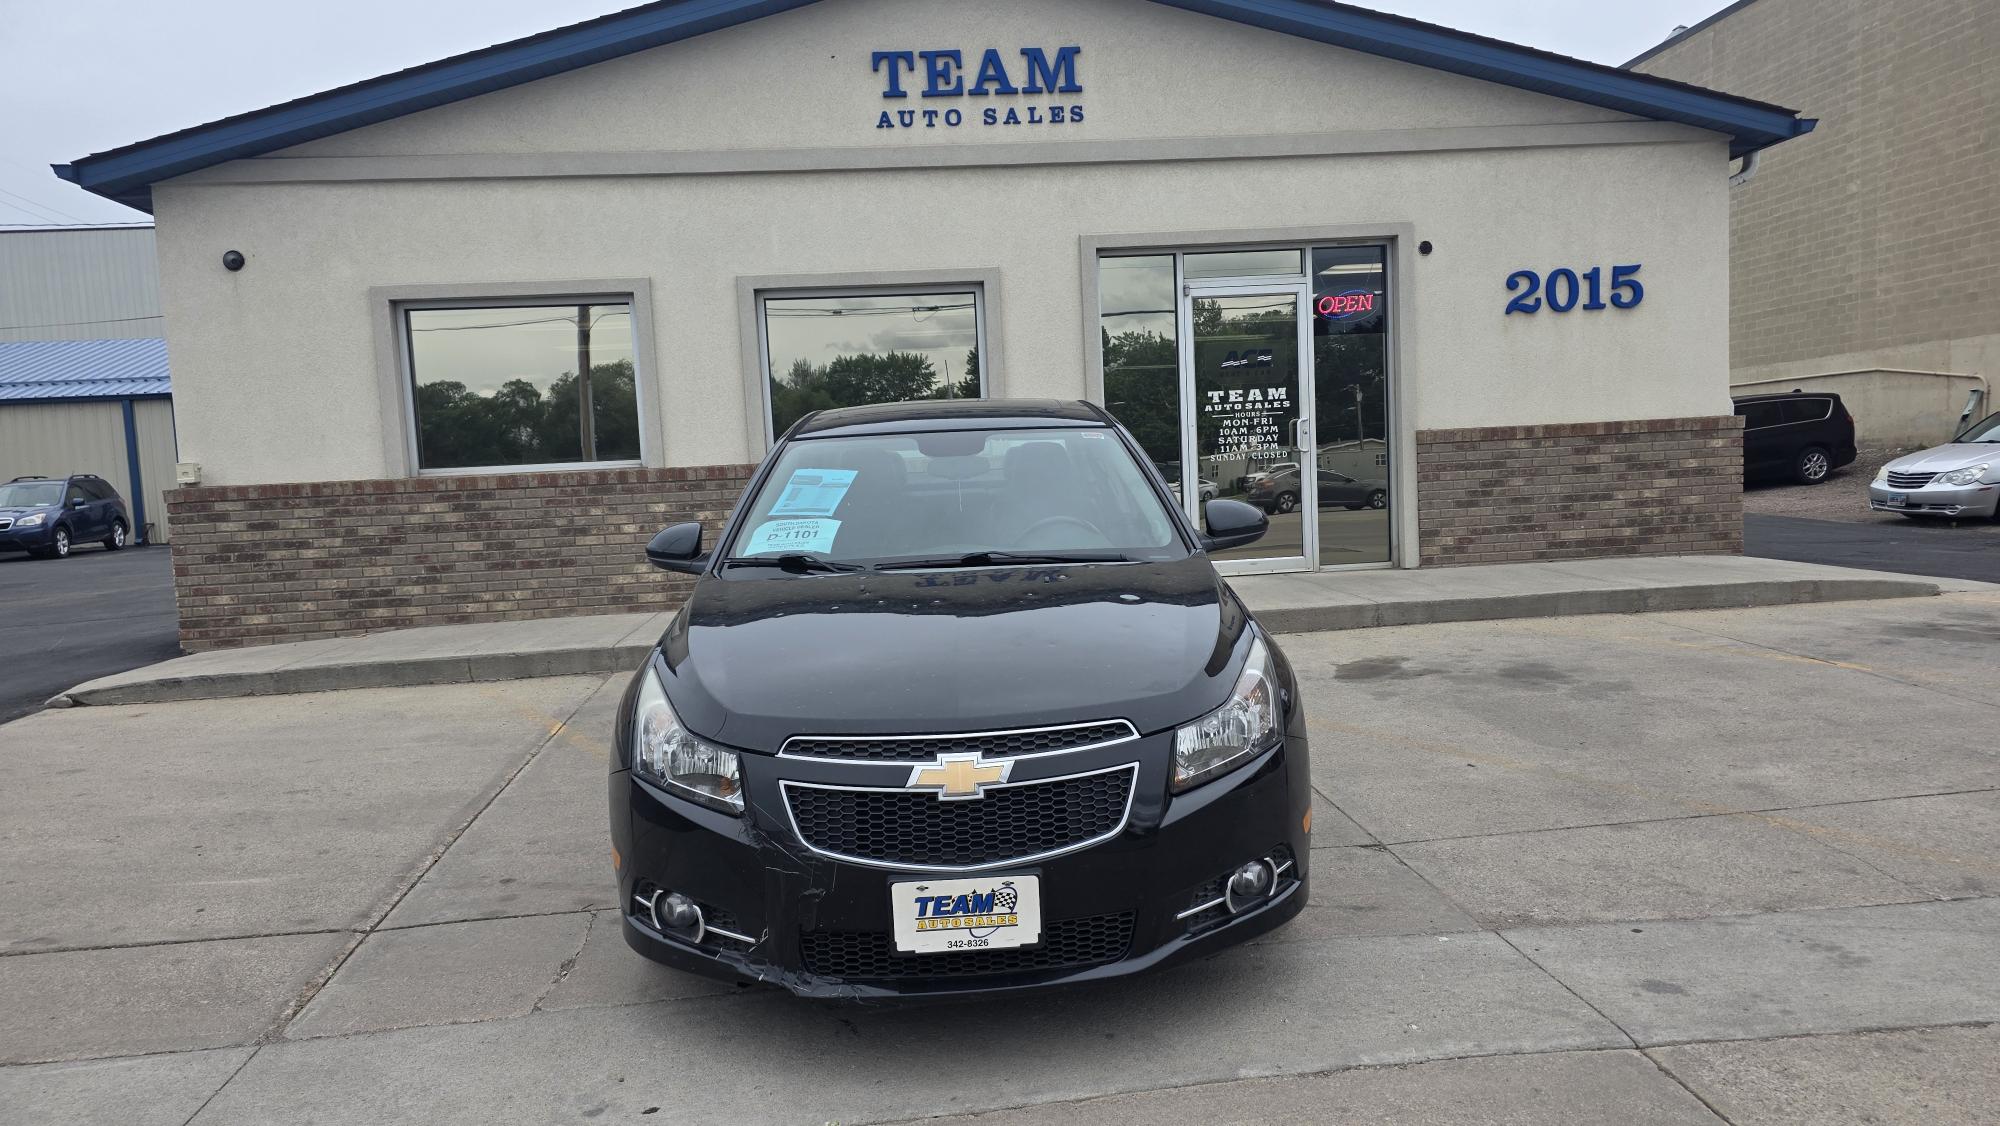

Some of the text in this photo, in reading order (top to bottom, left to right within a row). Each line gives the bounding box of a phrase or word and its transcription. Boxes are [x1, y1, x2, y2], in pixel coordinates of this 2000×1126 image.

[872, 46, 1083, 98] TEAM
[876, 105, 1084, 128] AUTO SALES
[1505, 264, 1644, 315] 2015
[1318, 294, 1374, 314] OPEN
[1221, 348, 1273, 369] ACE
[1207, 387, 1287, 403] TEAM
[1204, 401, 1291, 412] AUTO SALES
[1223, 417, 1273, 427] MON-FRI
[1219, 427, 1248, 436] 10AM
[1256, 425, 1279, 434] 6PM
[1218, 434, 1279, 445] SATURDAY
[1220, 444, 1248, 453] 11AM
[1256, 442, 1279, 451] 3PM
[1210, 450, 1288, 462] SUNDAY CLOSED
[767, 530, 819, 541] D-1101
[914, 892, 996, 917] TEAM
[917, 914, 1018, 929] AUTO SALES
[947, 938, 989, 949] 342-8326
